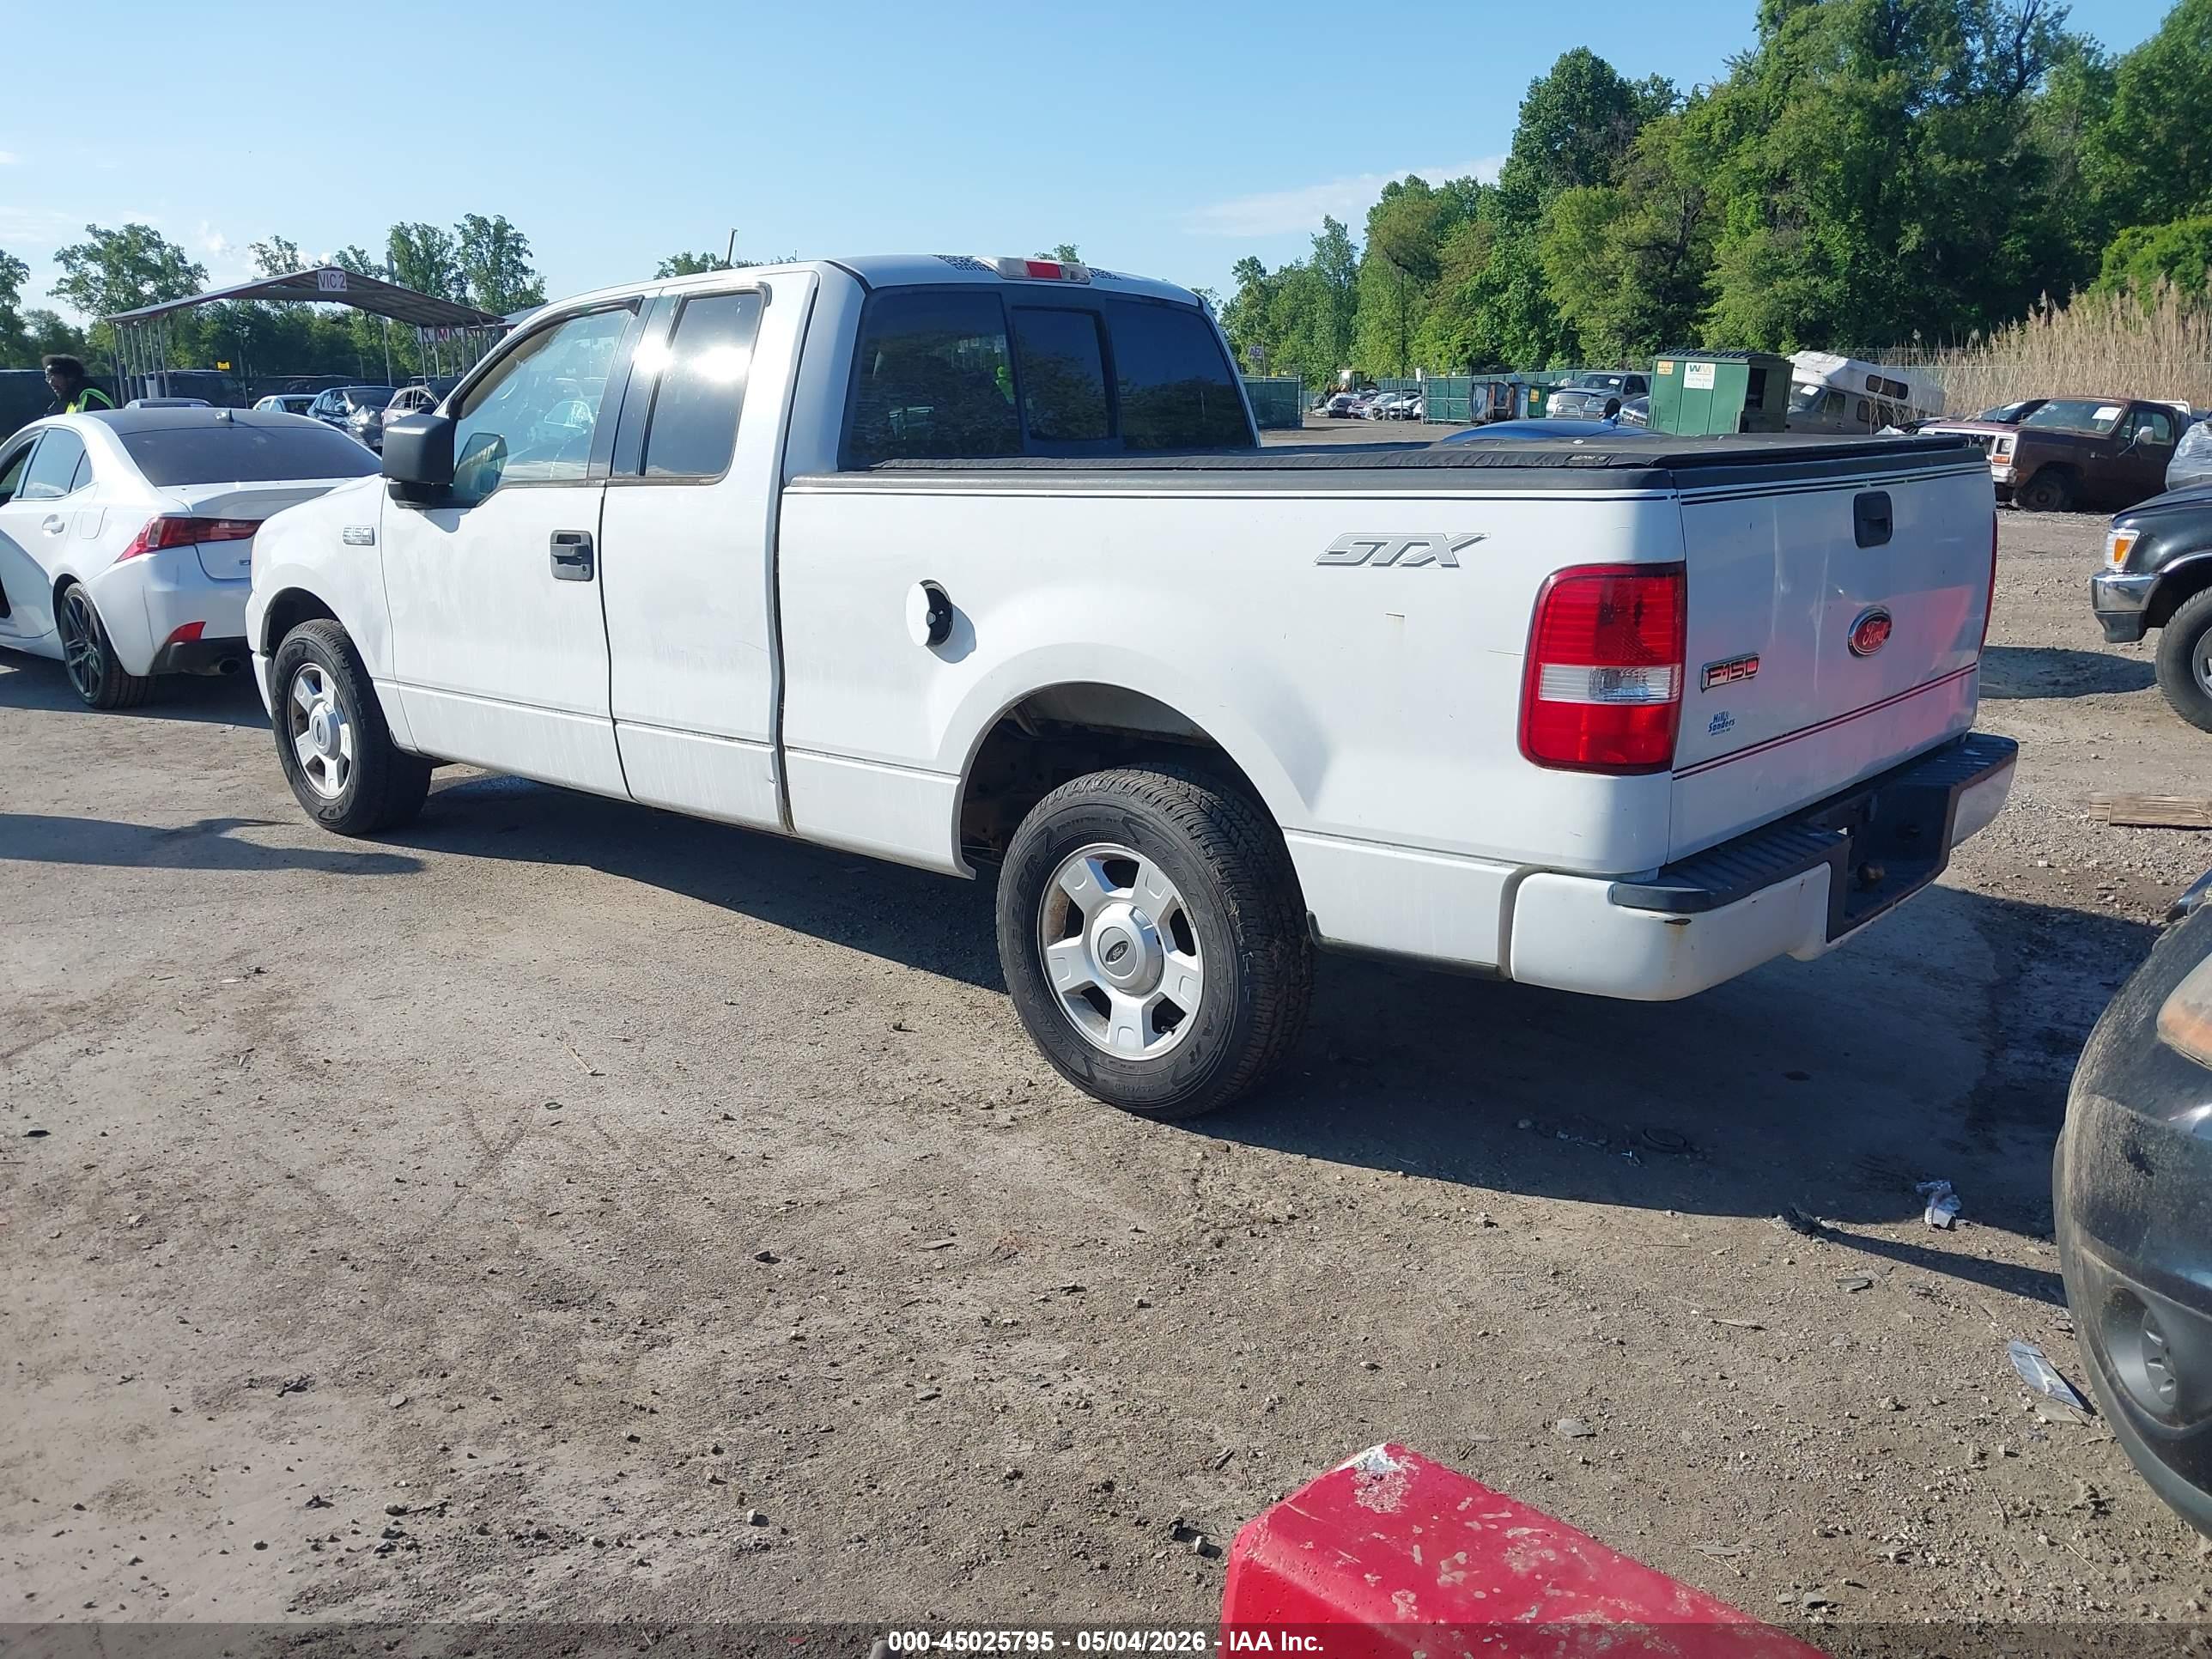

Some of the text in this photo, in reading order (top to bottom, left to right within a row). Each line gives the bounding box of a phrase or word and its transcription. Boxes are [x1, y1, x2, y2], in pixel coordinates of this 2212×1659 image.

[319, 273, 346, 289] VIC 2
[1312, 532, 1491, 569] STX
[1862, 619, 1887, 647] Ford
